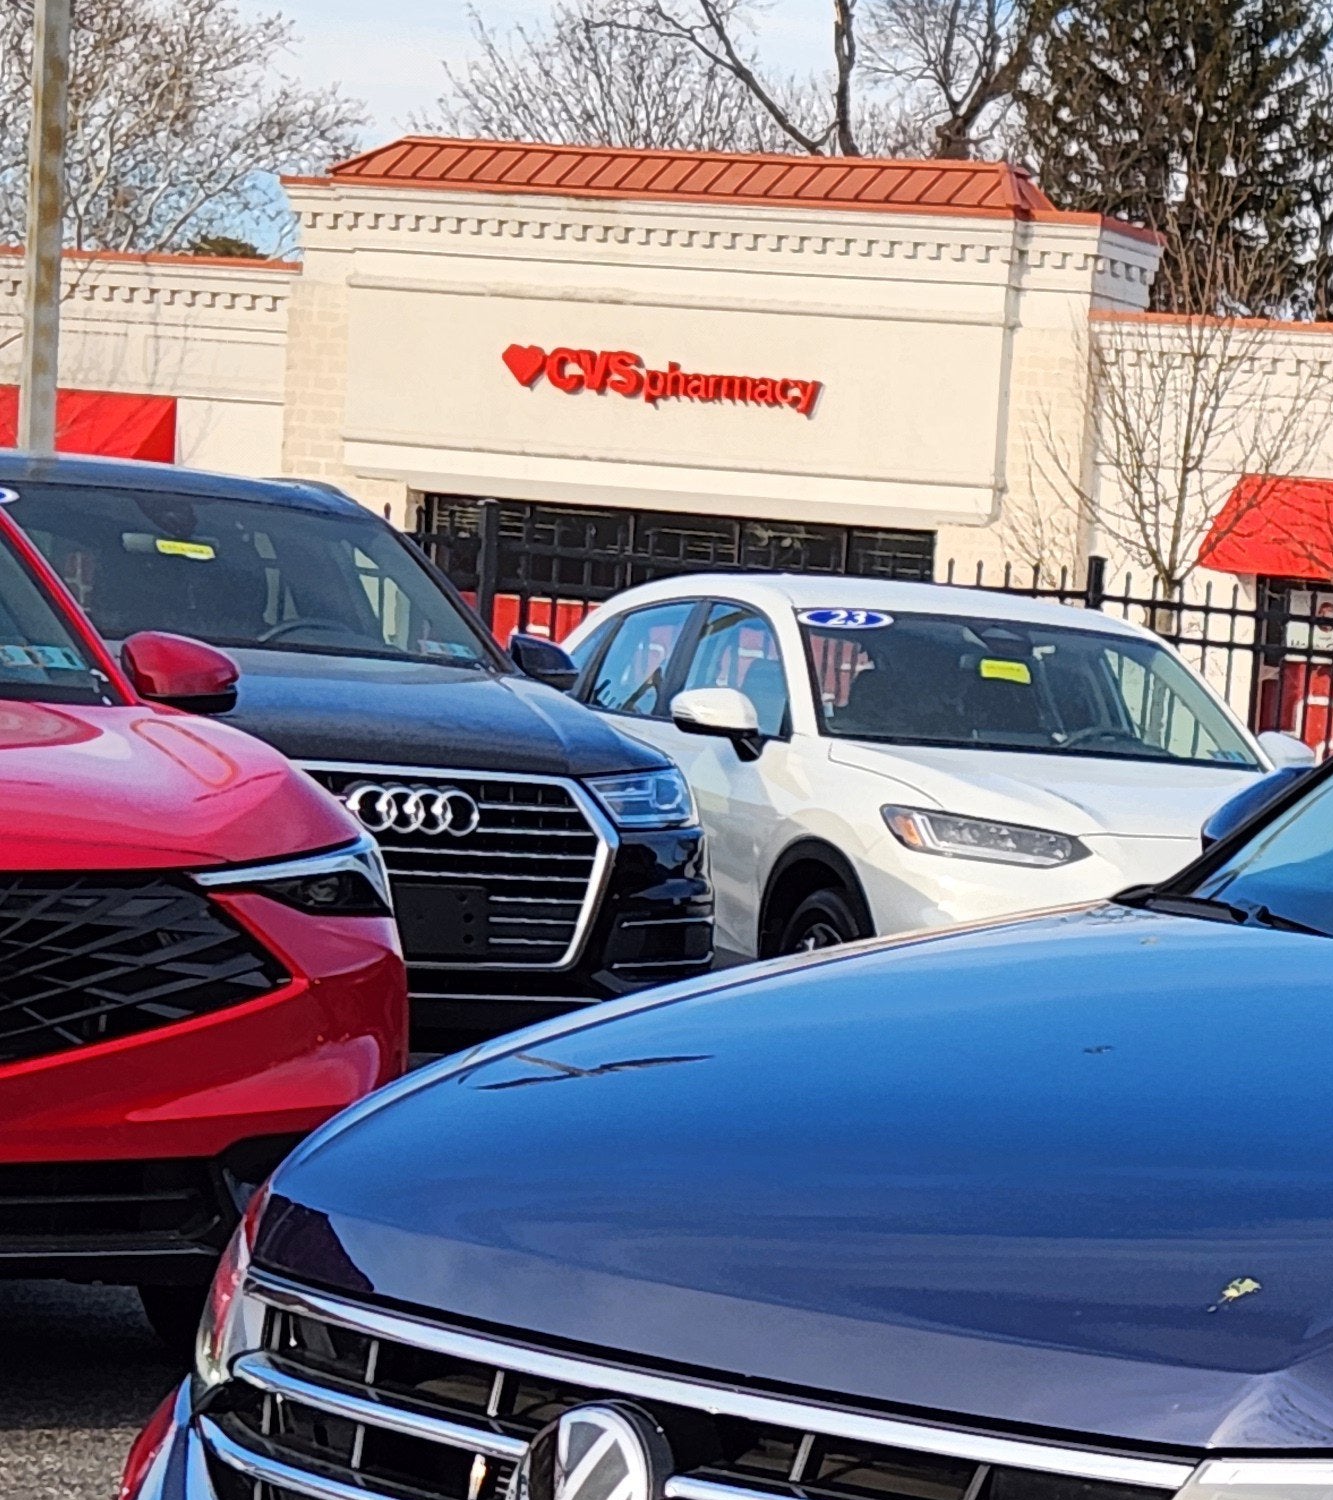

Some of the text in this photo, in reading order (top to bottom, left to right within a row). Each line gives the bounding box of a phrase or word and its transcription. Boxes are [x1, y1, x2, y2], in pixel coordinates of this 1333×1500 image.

[546, 347, 822, 418] CVS pharmacy
[828, 609, 867, 626] 23
